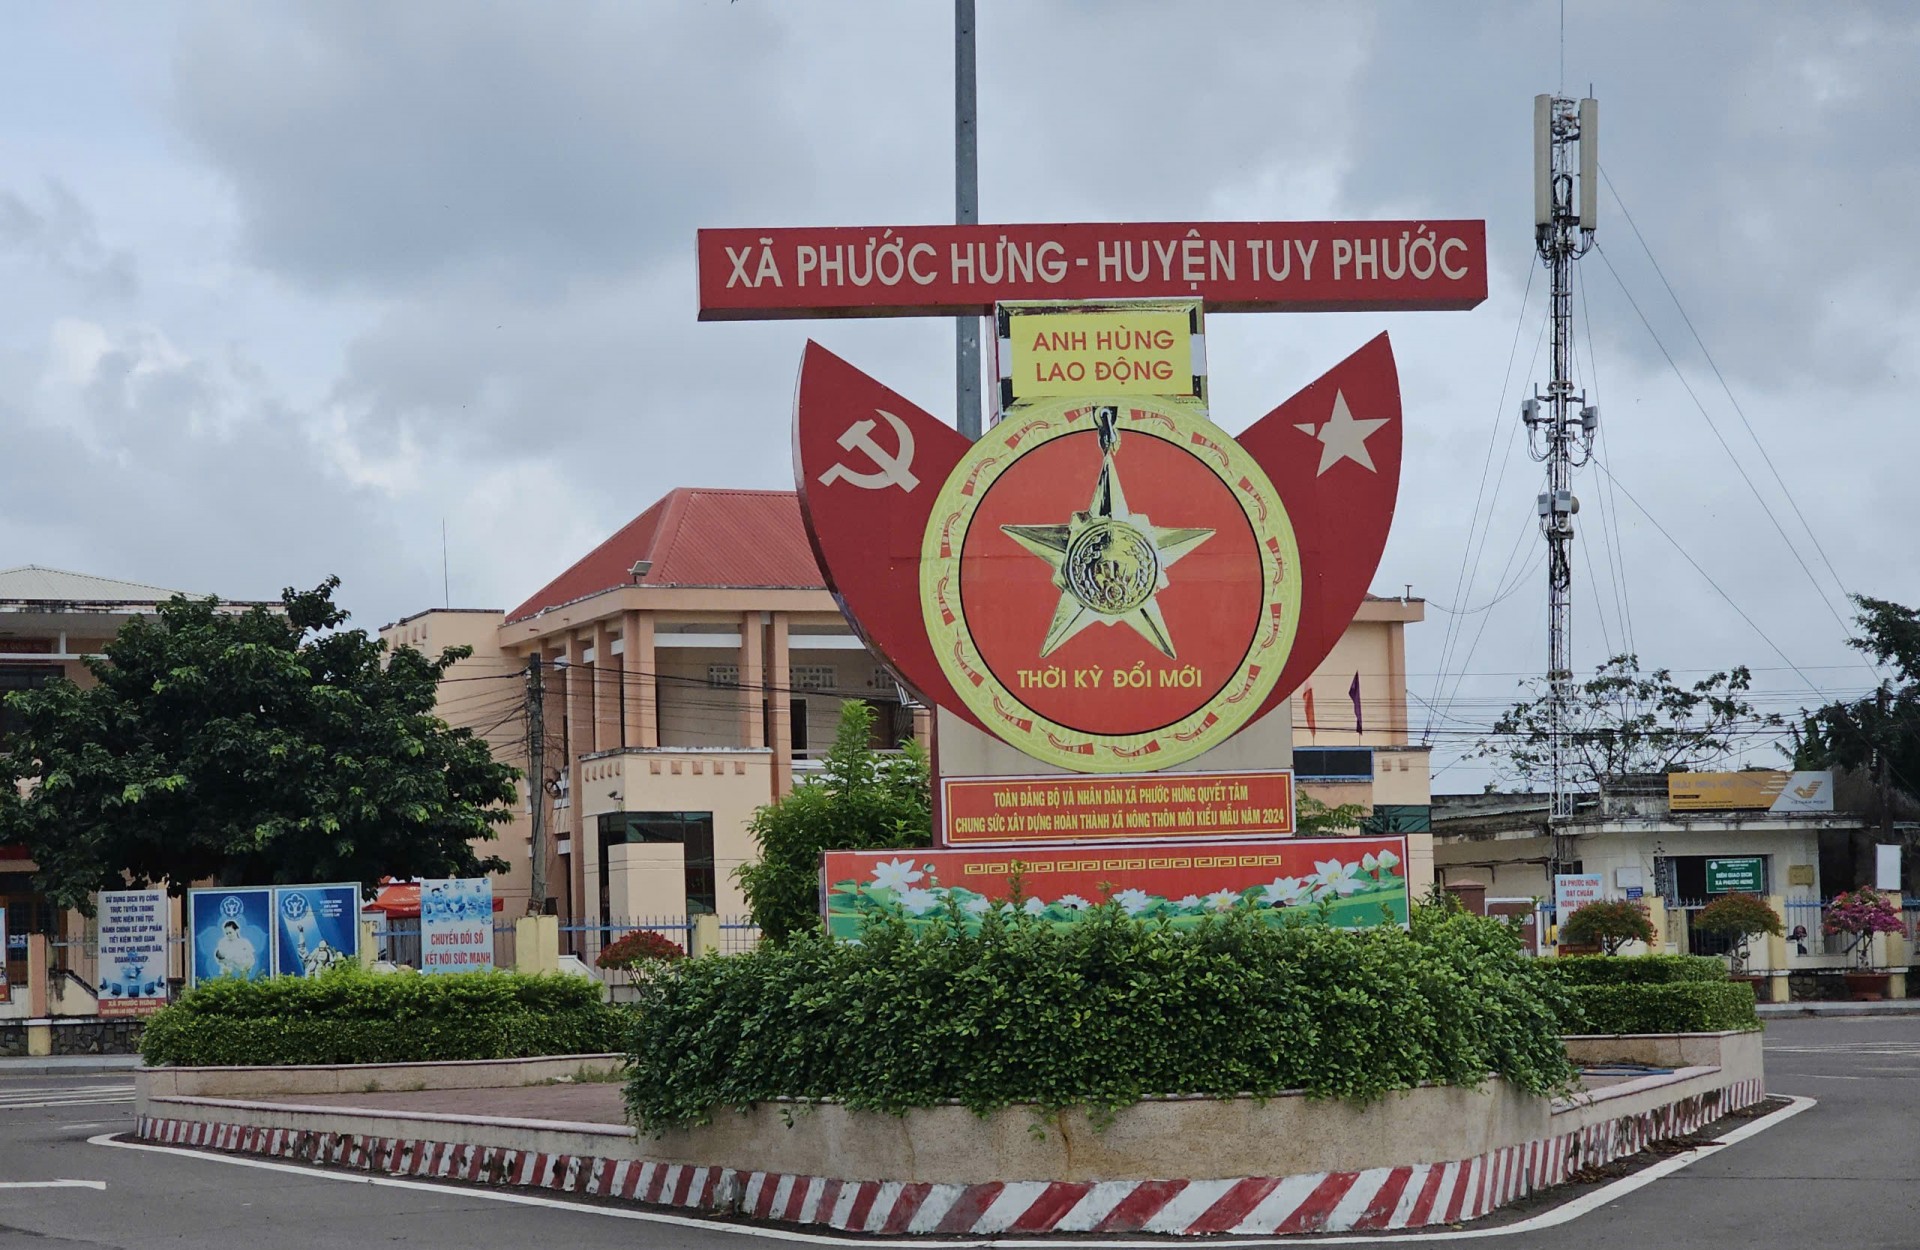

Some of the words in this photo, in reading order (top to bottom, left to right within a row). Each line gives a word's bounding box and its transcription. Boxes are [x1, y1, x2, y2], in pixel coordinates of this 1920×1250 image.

[725, 237, 783, 288] XÃ
[797, 228, 937, 286] PHƯỚC
[951, 235, 1068, 284] HƯNG
[1098, 228, 1236, 290] HUYỆN
[1247, 239, 1319, 281] TUY
[1333, 224, 1469, 280] PHƯỚC
[1032, 331, 1087, 351] ANH
[1096, 325, 1174, 350] HÙNG
[1036, 362, 1085, 381] LAO
[1095, 356, 1173, 385] ĐỘNG
[1017, 665, 1067, 688] THỜI
[1074, 664, 1104, 688] KỲ
[1113, 660, 1152, 688] ĐỔI
[1159, 664, 1202, 688] MỚI
[993, 788, 1018, 808] TOÀN
[1020, 785, 1045, 807] ĐẢNG
[1047, 787, 1060, 809] BỘ
[1062, 786, 1075, 806] VÀ
[1077, 786, 1102, 805] NHÂN
[1104, 785, 1123, 804] DÂN
[1125, 785, 1137, 804] XÃ
[1139, 784, 1170, 804] PHƯỚC
[1171, 784, 1196, 803] HƯNG
[1198, 780, 1227, 804] QUYẾT
[1228, 782, 1249, 801] TÂM
[955, 816, 985, 833] CHUNG
[987, 812, 1006, 832] SỨC
[1007, 812, 1025, 831] XÂY
[1027, 812, 1052, 834] DỰNG
[1053, 811, 1078, 830] HOÀN
[1079, 810, 1110, 829] THÀNH
[1111, 810, 1124, 829] XÃ
[1126, 809, 1150, 828] NÔNG
[1151, 808, 1176, 827] THÔN
[1177, 807, 1195, 826] MỚI
[1196, 803, 1217, 826] KIỂU
[1219, 803, 1239, 825] MẪU
[1241, 806, 1261, 824] NĂM
[1262, 808, 1285, 824] 2024
[431, 929, 458, 945] CHUYỂN
[473, 928, 484, 944] SỐ
[424, 950, 437, 965] KẾT
[439, 949, 452, 964] NỐI
[453, 951, 468, 964] SỨC
